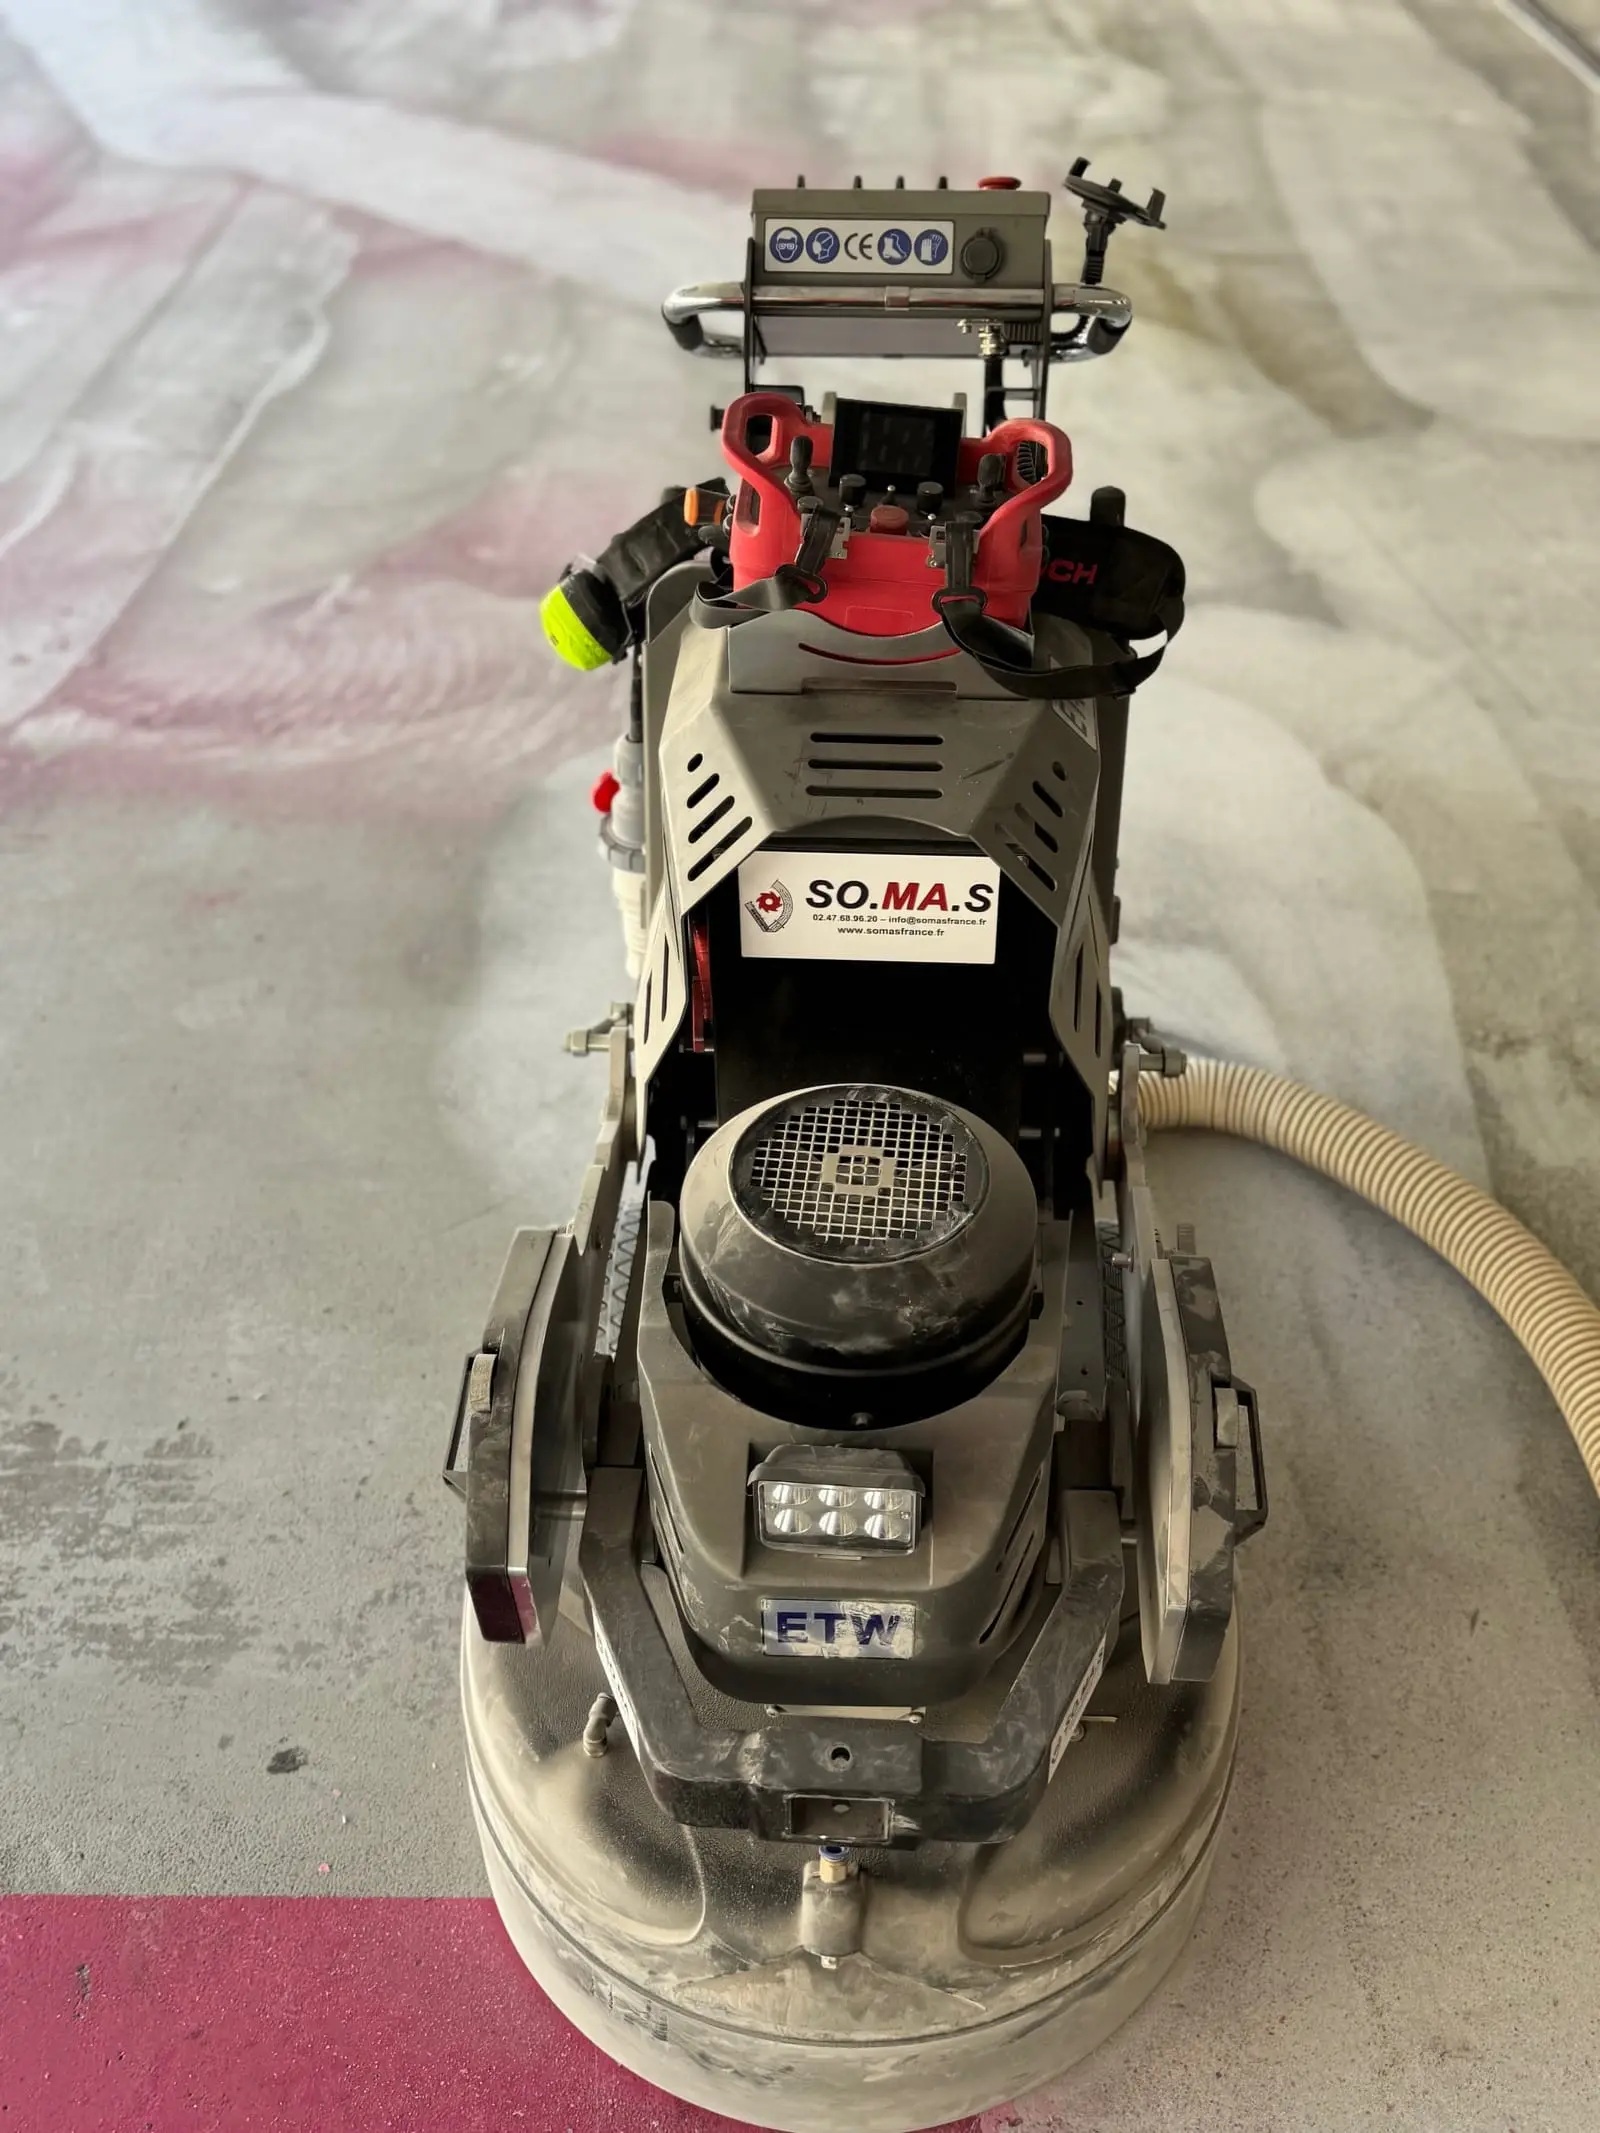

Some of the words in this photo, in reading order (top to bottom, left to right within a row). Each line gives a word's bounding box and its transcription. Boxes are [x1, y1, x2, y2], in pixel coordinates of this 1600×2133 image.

[844, 232, 873, 260] CE
[1047, 557, 1099, 585] CH
[805, 879, 995, 913] SO.MA.S
[837, 927, 945, 937] www.somasfrance.fr
[888, 915, 987, 926] info@somasfrance.fr
[776, 1611, 901, 1646] ETW
